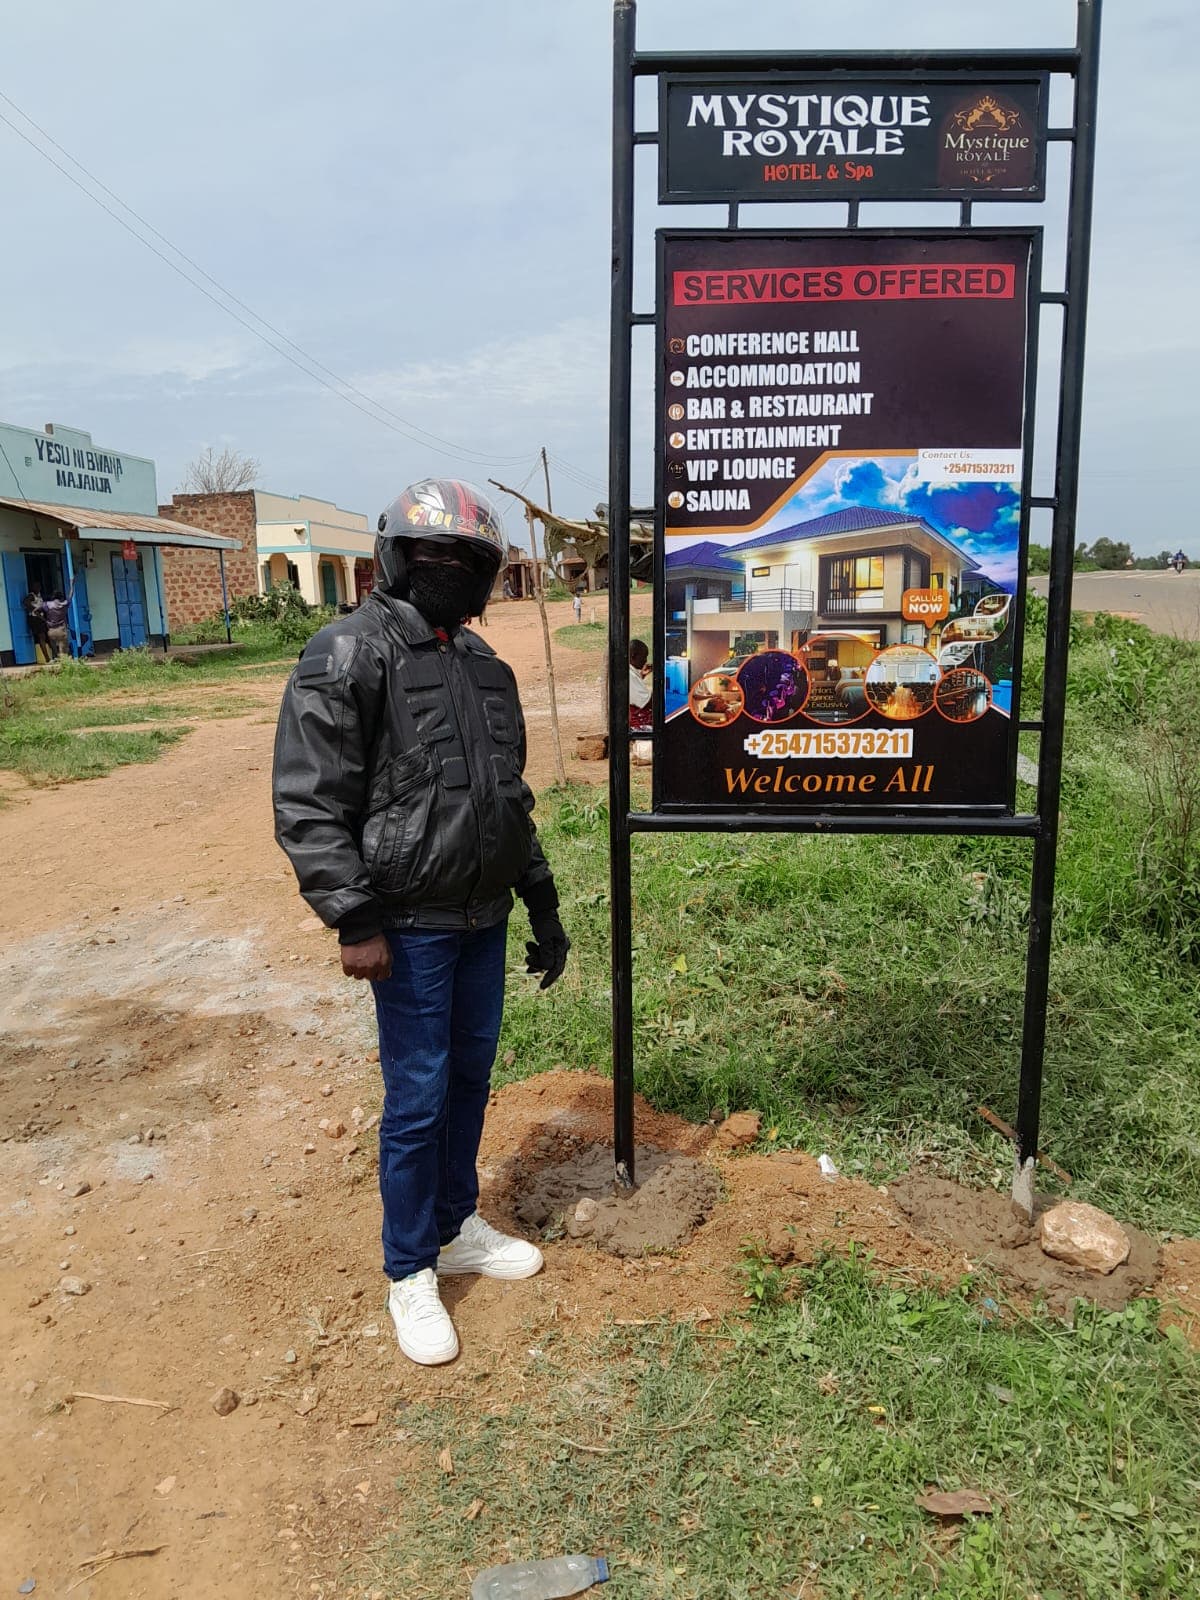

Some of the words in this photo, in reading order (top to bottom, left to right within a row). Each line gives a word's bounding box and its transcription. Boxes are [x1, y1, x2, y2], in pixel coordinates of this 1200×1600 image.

[687, 94, 932, 128] MYSTIQUE
[722, 129, 905, 157] ROYALE
[944, 133, 1030, 153] Mystique
[956, 151, 1011, 162] ROYALE
[763, 163, 822, 182] HOTEL
[826, 163, 840, 179] &
[844, 161, 874, 180] Spa
[683, 271, 843, 302] SERVICES
[853, 268, 1007, 297] OFFERED
[686, 332, 810, 357] CONFERENCE
[813, 330, 859, 354] HALL
[686, 362, 861, 389] ACCOMMODATION
[687, 397, 726, 420] BAR
[730, 397, 745, 419] &
[749, 393, 874, 418] RESTAURANT
[687, 425, 842, 451] ENTERTAINMENT
[35, 438, 70, 466] YESU
[73, 447, 85, 470] NI
[86, 451, 123, 475] BWANA
[922, 451, 957, 459] Contact
[686, 459, 719, 482] VIP
[723, 457, 796, 480] LOUNGE
[943, 463, 1015, 474] +254715373211
[56, 469, 112, 494] MAJANJA
[686, 489, 751, 512] SAUNA
[909, 603, 943, 614] NOW
[931, 594, 944, 602] US
[747, 733, 909, 756] +254715373211
[723, 766, 876, 794] Welcome
[886, 765, 936, 793] All
